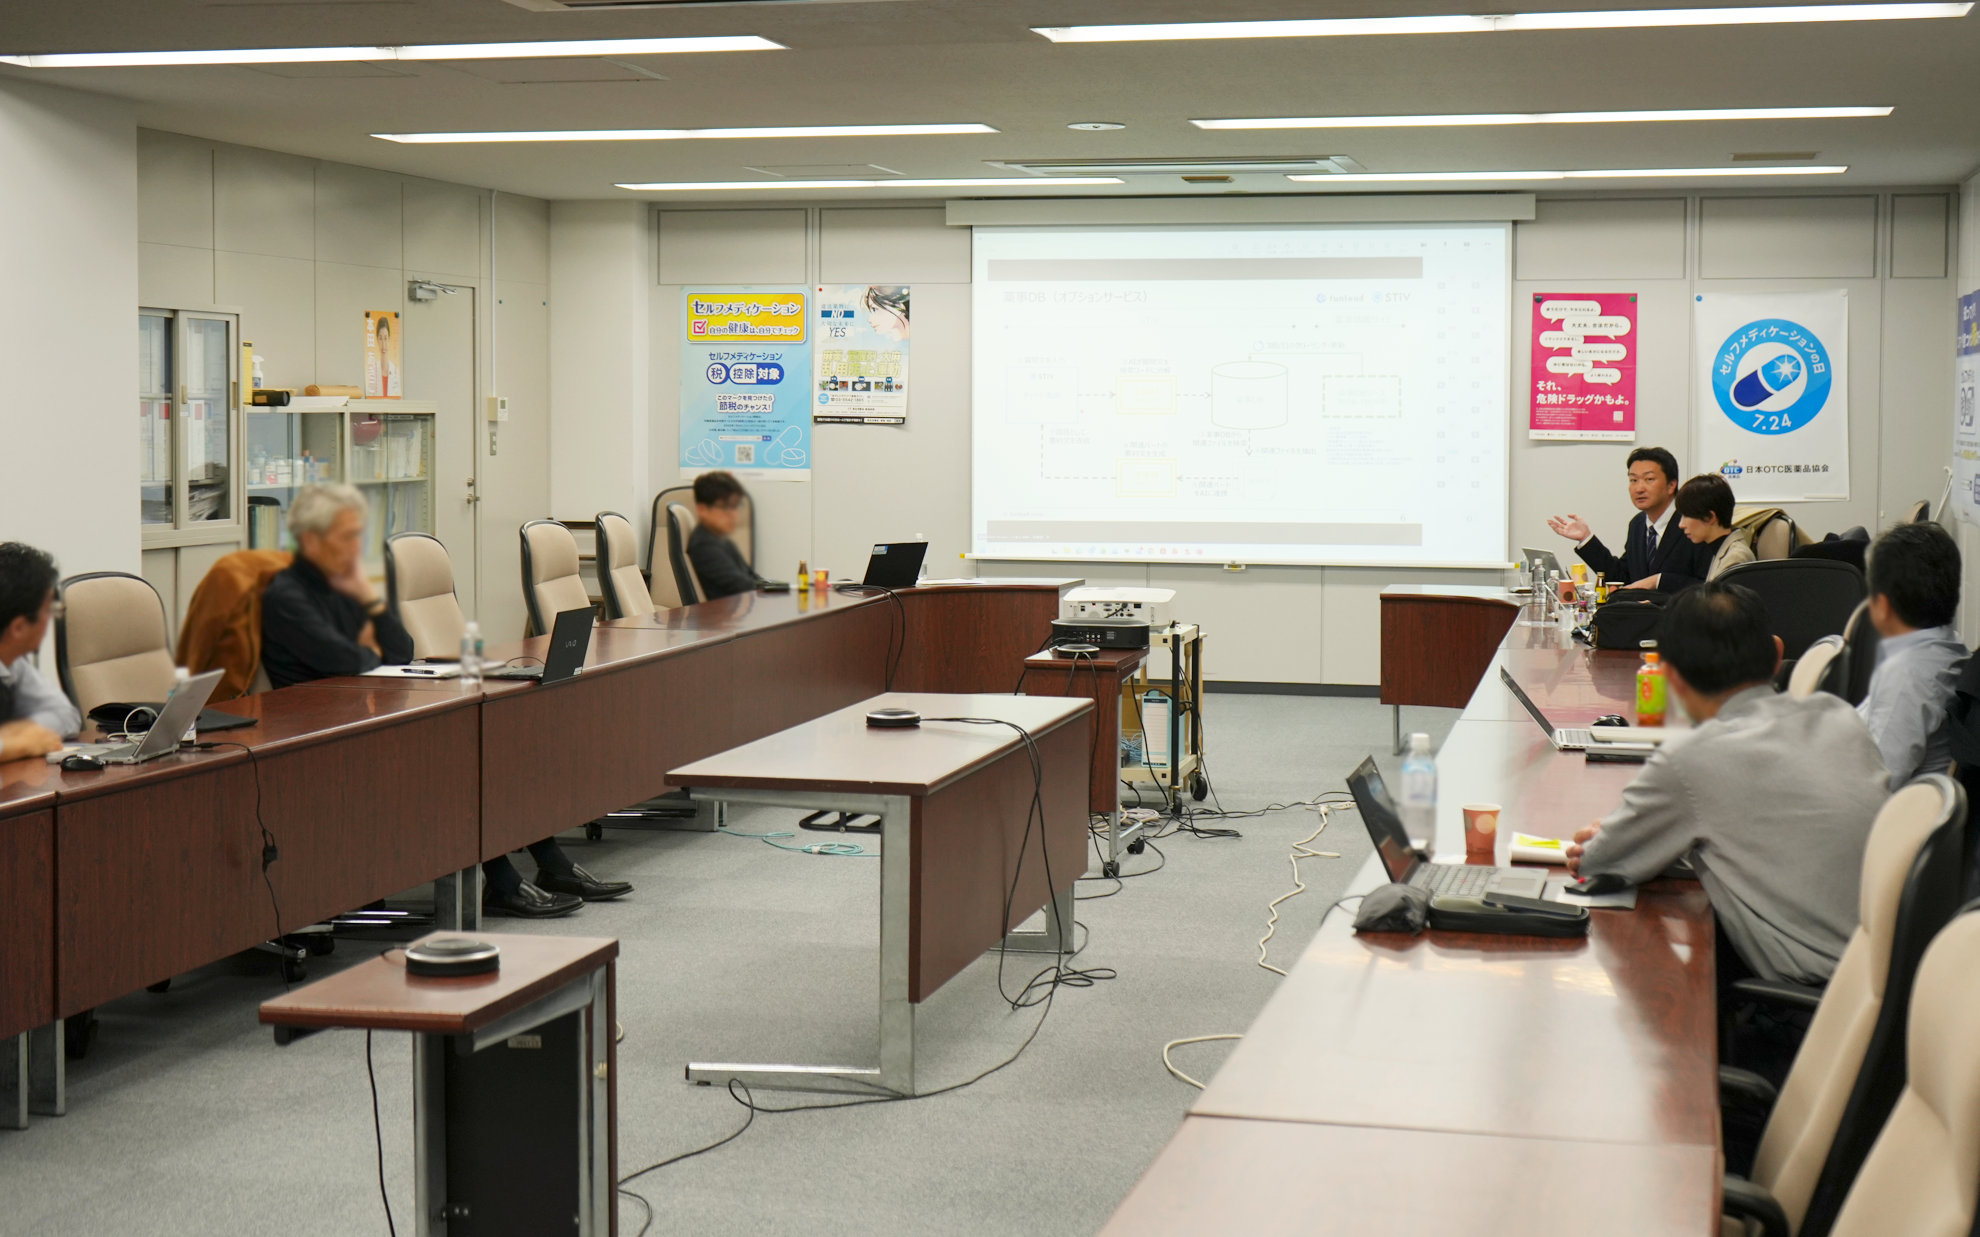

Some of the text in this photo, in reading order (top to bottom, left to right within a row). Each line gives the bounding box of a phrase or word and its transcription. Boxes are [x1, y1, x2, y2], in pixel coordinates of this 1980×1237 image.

[692, 300, 800, 315] セルフメディケーション
[831, 309, 845, 319] NO
[367, 318, 375, 348] 本田
[709, 322, 800, 335] 自分の健康は、自分でチェック
[829, 327, 847, 338] YES
[708, 352, 783, 361] セルフメディケーション
[1719, 326, 1826, 376] セルフメディケーションの日
[821, 361, 902, 377] 乱用防止運動
[1536, 380, 1562, 391] それ、
[1536, 393, 1630, 405] 危険ドラッグかもよ。
[1752, 413, 1792, 431] 7.24
[1723, 465, 1740, 474] OTC
[1746, 464, 1830, 474] 日本OTC医薬品協会
